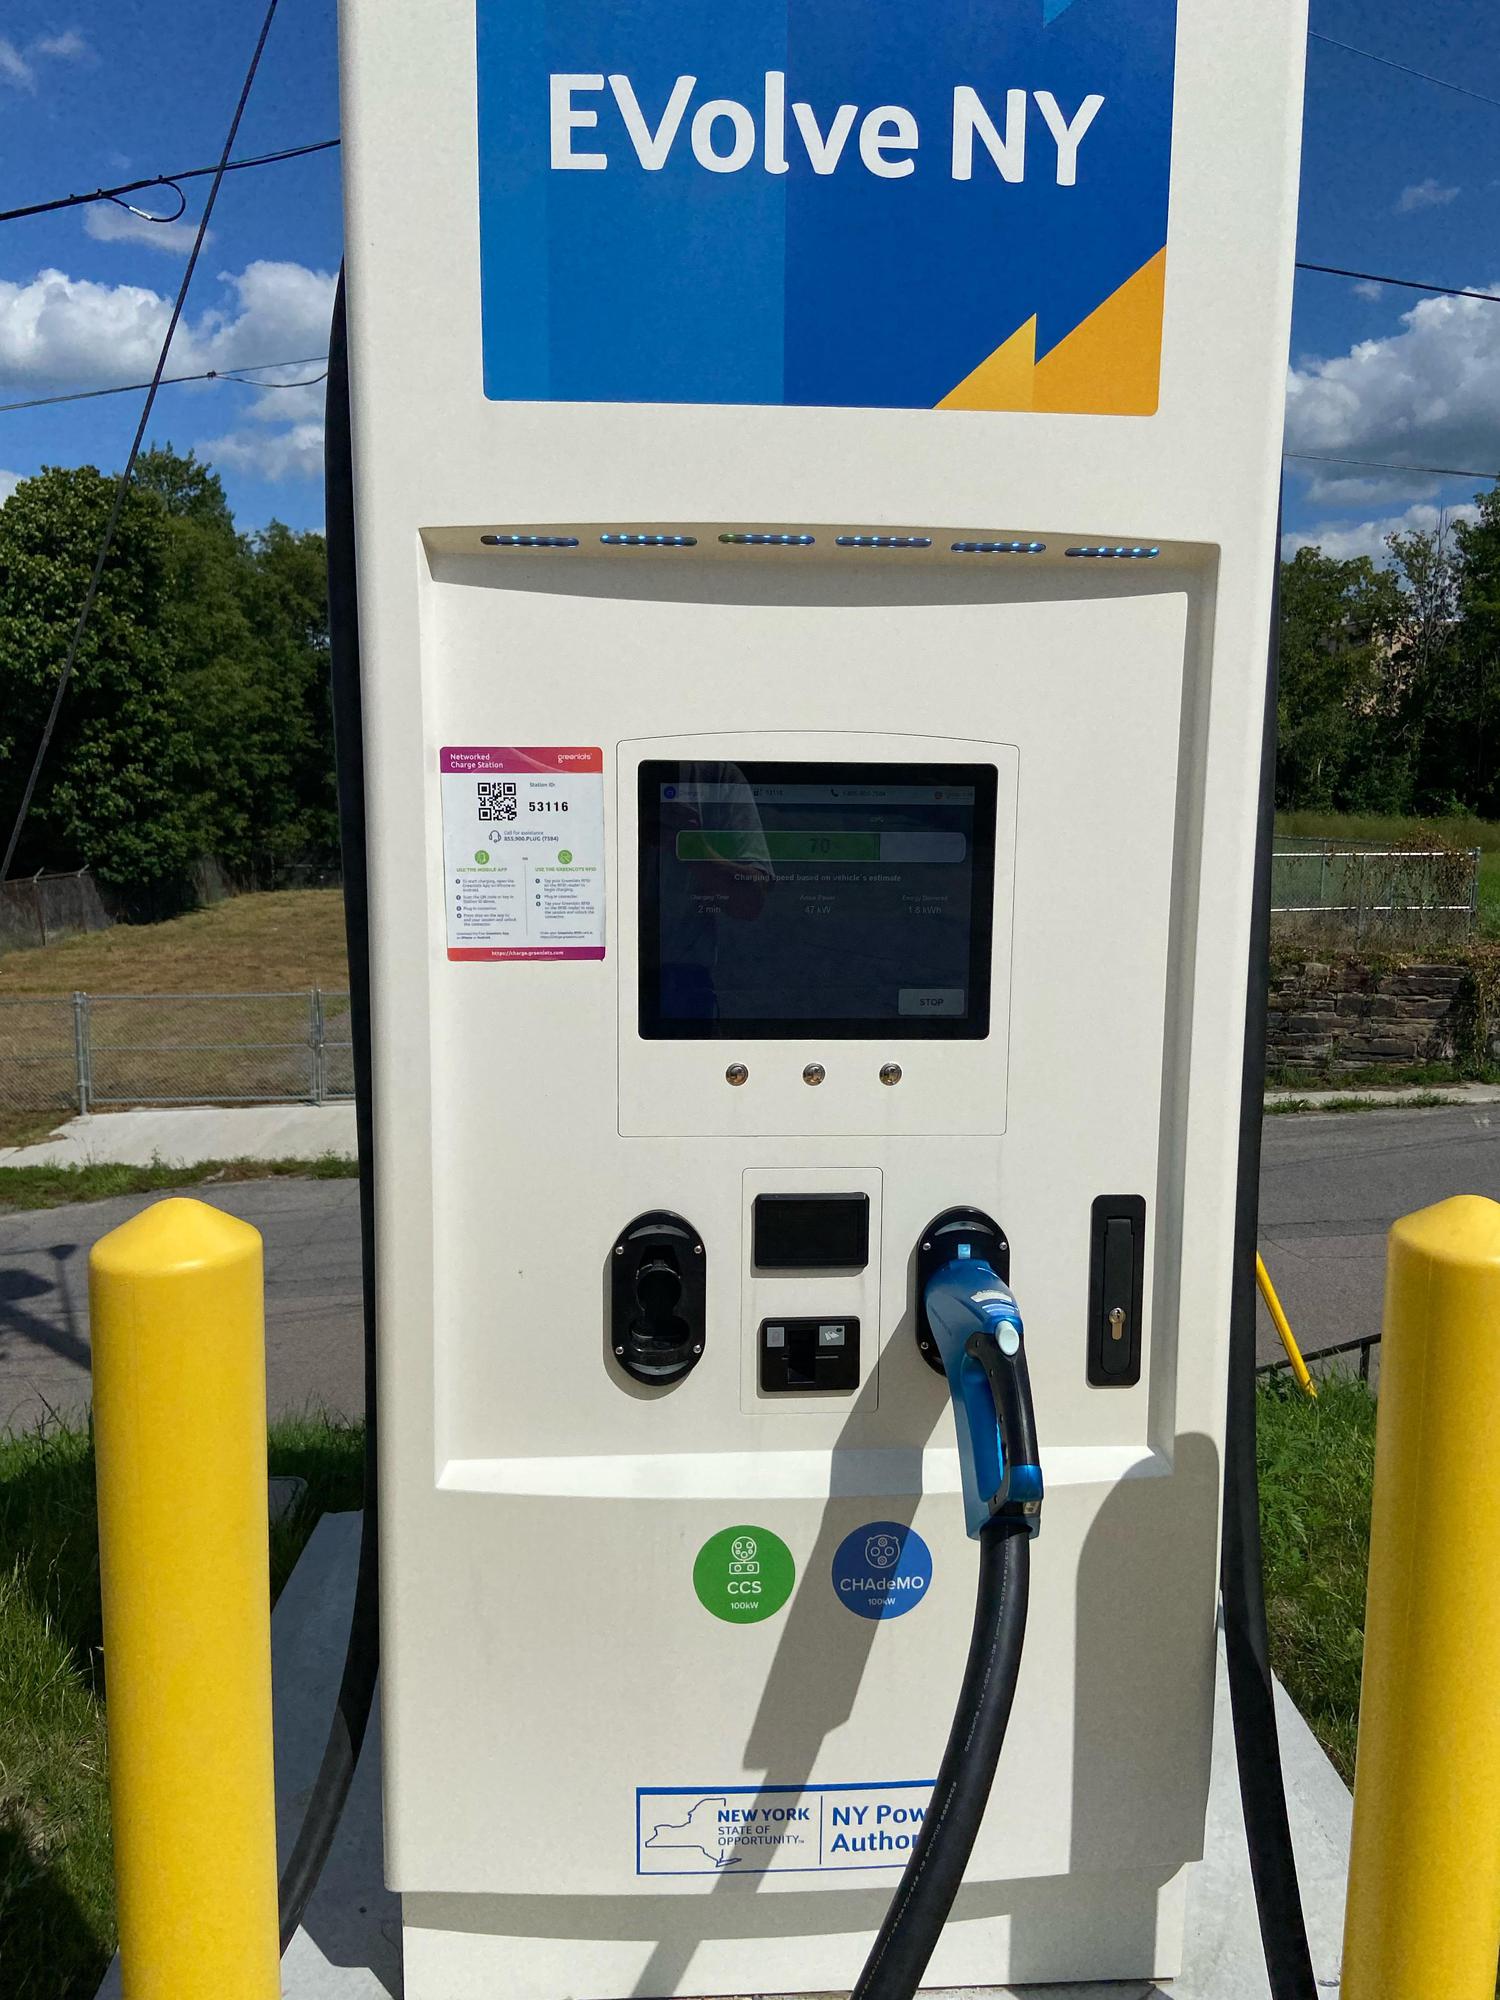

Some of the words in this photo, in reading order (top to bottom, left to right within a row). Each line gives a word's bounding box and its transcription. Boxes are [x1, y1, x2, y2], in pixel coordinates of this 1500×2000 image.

[549, 70, 919, 178] EVolve
[951, 85, 1105, 186] NY
[558, 754, 592, 764] greenlots
[450, 762, 476, 770] Charge
[528, 802, 568, 812] 53116
[734, 873, 770, 882] Charging
[706, 905, 721, 913] min
[920, 998, 944, 1006] STOP
[727, 1580, 762, 1594] CCS
[840, 1576, 924, 1592] CHAdeMO
[730, 1602, 759, 1610] 100kW
[868, 1597, 896, 1606] 100kW
[718, 1808, 760, 1822] NEW
[761, 1807, 810, 1822] YORK
[832, 1806, 868, 1826] NY
[876, 1804, 929, 1824] Pow
[718, 1826, 752, 1835] STATE
[755, 1825, 770, 1834] OF
